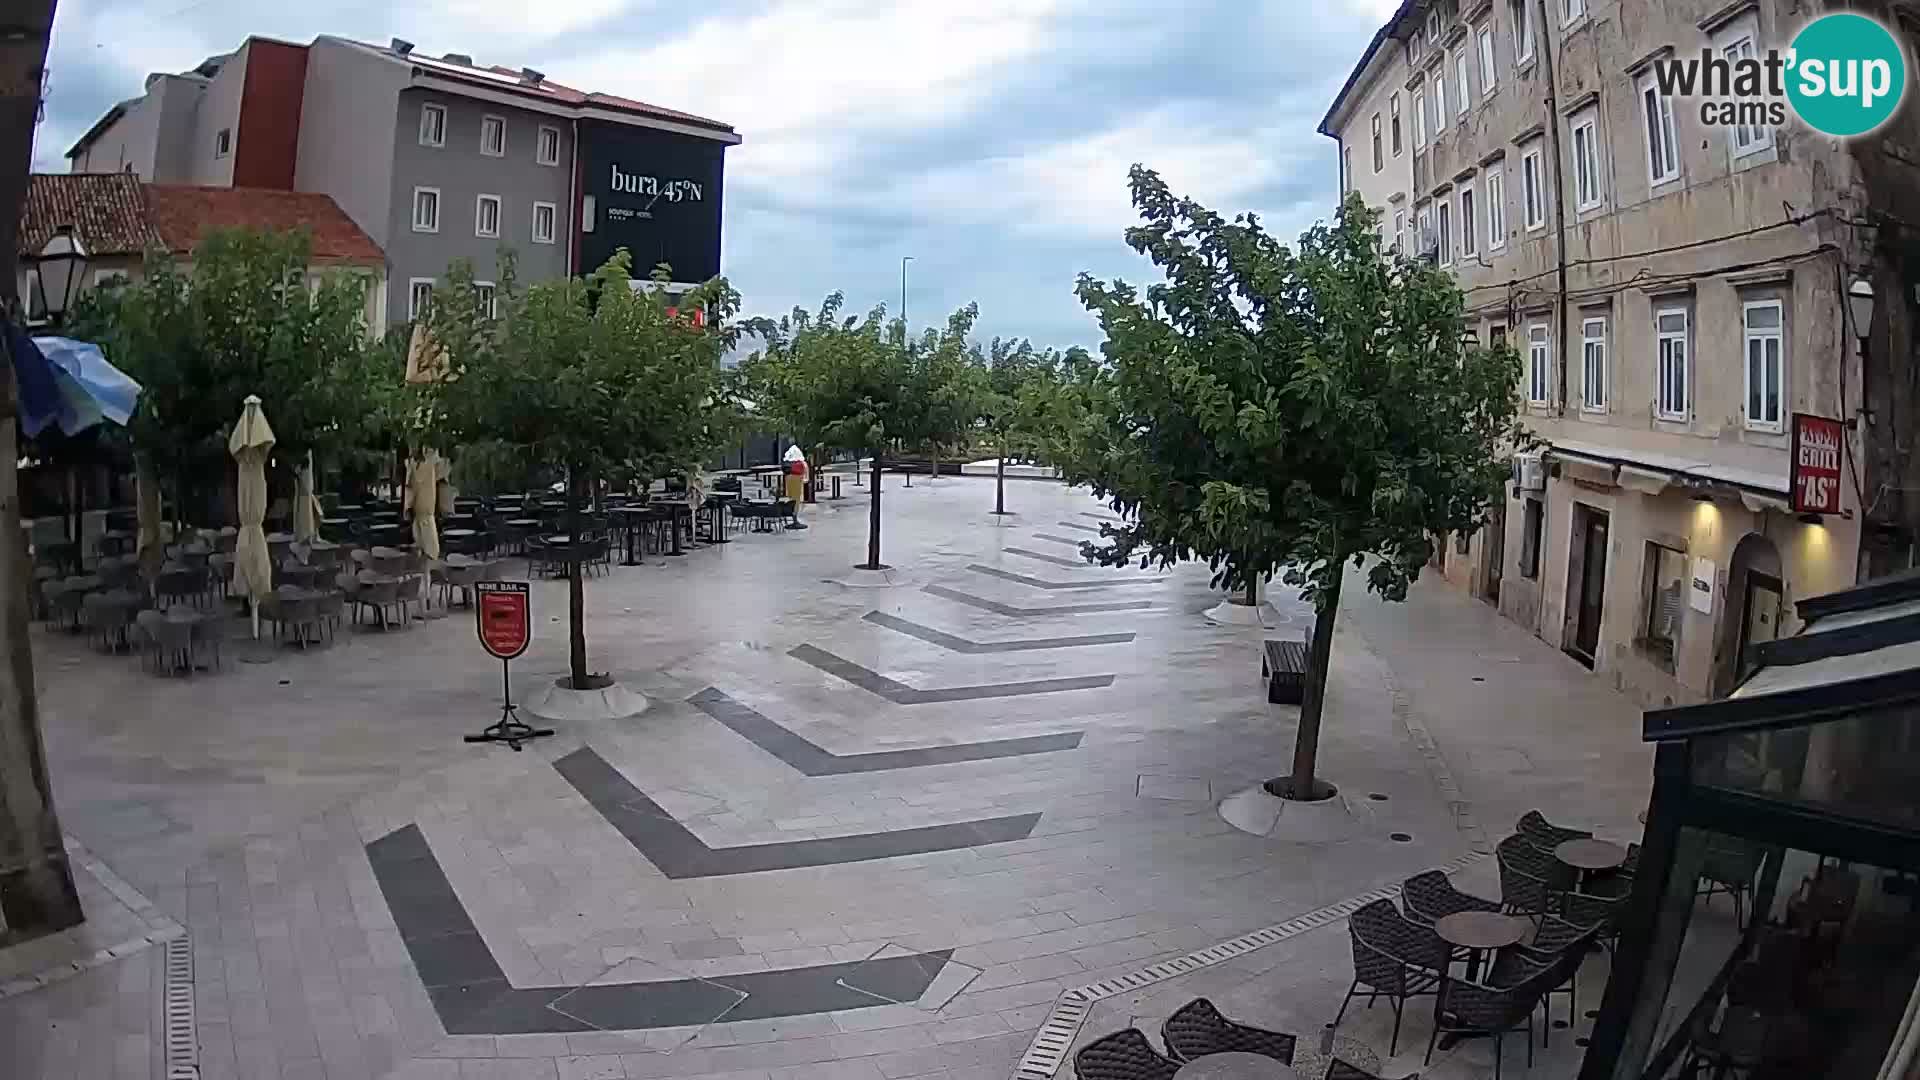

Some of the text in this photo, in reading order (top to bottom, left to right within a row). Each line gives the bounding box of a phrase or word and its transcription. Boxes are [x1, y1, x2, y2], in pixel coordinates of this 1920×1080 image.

[611, 164, 658, 195] bura
[1798, 446, 1839, 471] GRILL
[500, 583, 518, 591] BAR
